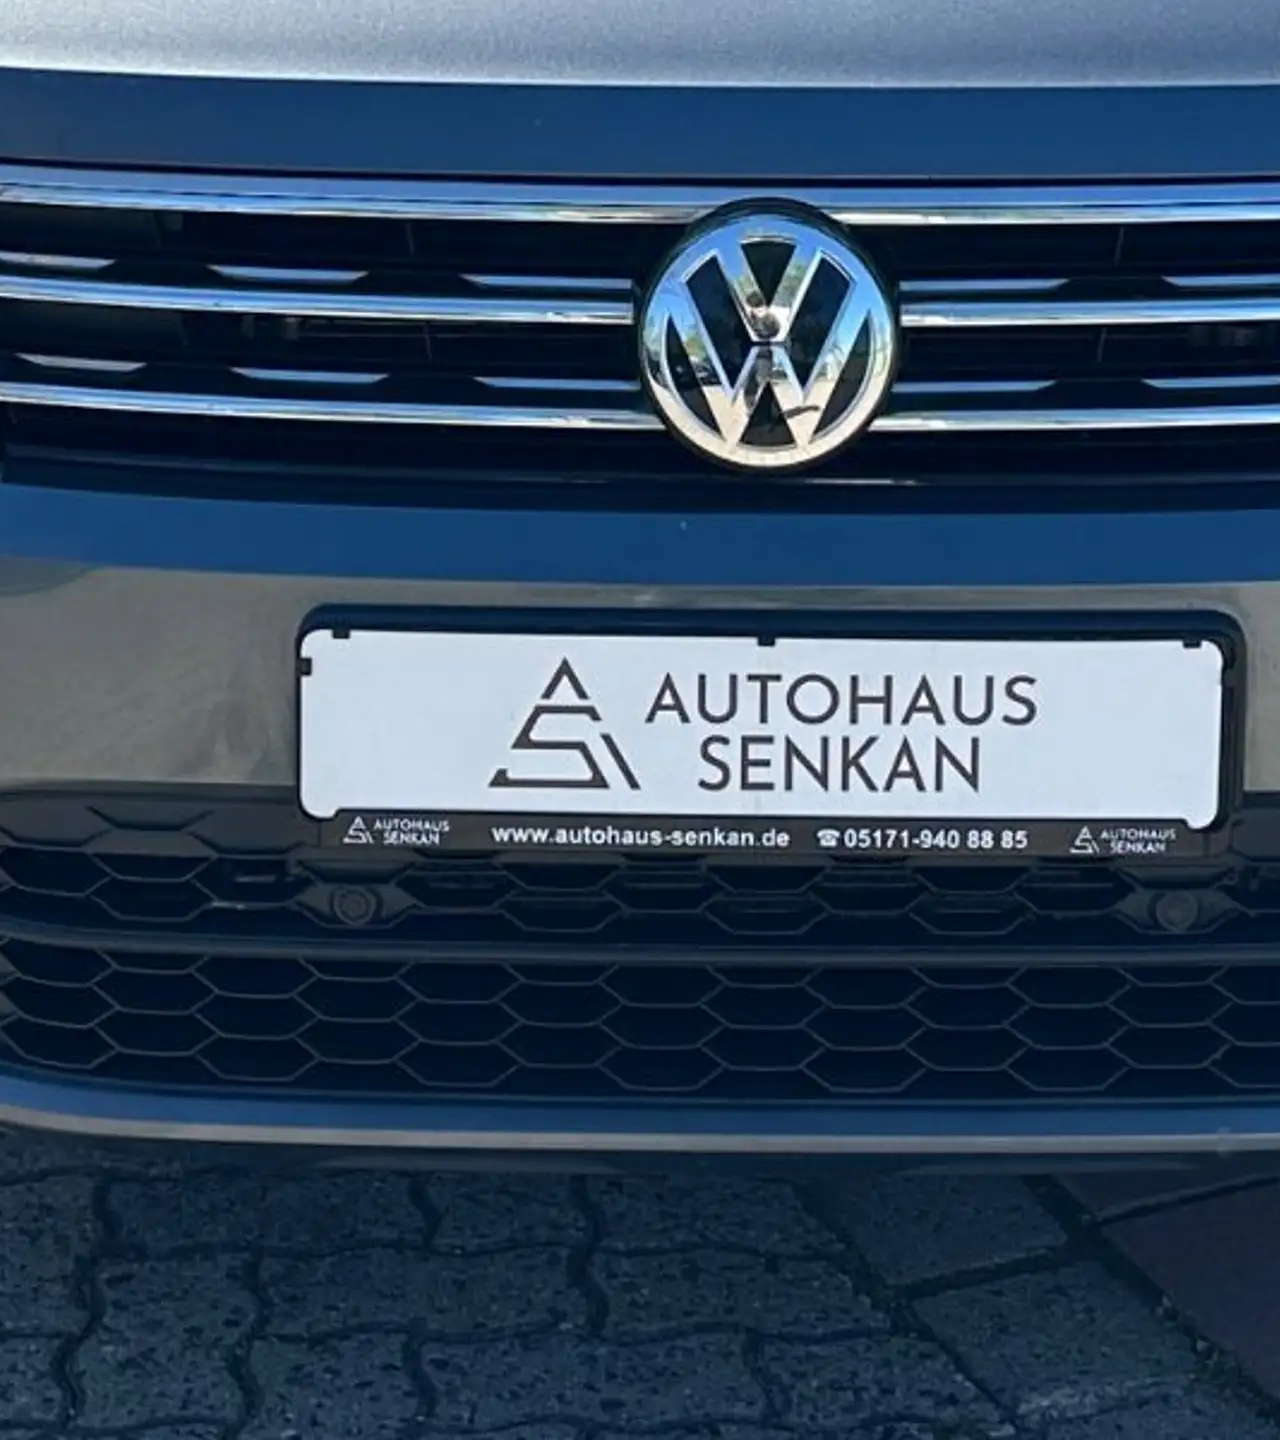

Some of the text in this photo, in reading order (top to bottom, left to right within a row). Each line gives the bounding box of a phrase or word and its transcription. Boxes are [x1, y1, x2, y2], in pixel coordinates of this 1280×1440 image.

[644, 672, 1039, 726] AUTOHAUS
[697, 734, 981, 793] SENKAN
[372, 817, 450, 832] AUTOHAUS
[383, 831, 440, 846] SENKAN
[491, 825, 1029, 849] www.autohaus-senkan.de 05171-940 88 85
[1100, 827, 1177, 841] AUTOHAUS
[1109, 840, 1167, 855] SENKAN
